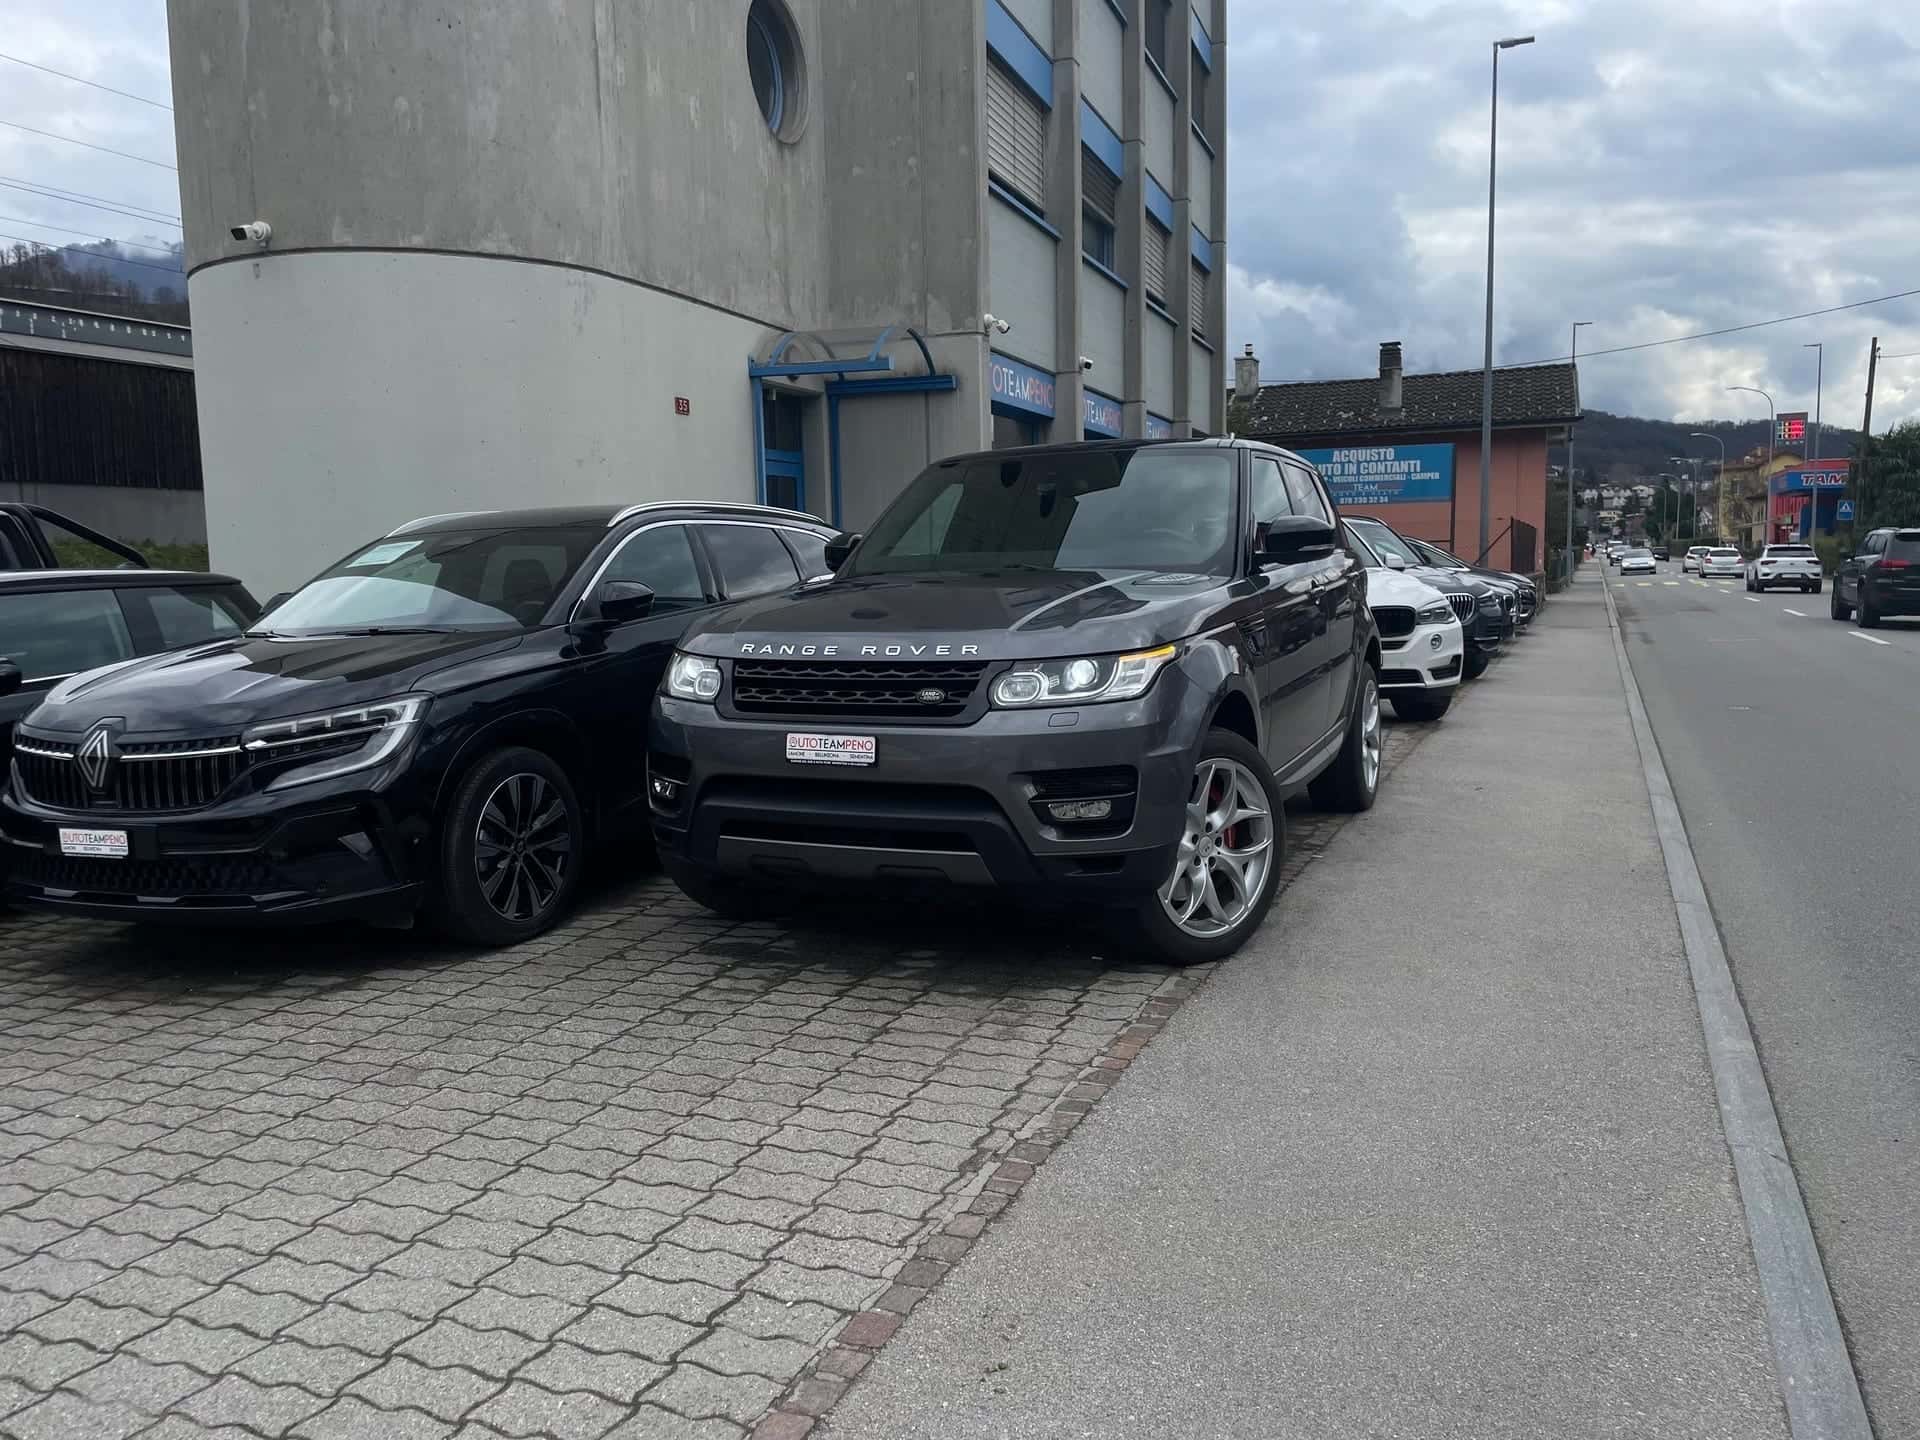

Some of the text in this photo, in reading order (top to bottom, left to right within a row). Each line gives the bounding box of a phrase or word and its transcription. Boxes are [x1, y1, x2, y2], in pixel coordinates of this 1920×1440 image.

[990, 362, 1055, 409] OTEAMPENO
[1333, 448, 1395, 463] ACQUISTO
[1344, 463, 1357, 475] IN
[1360, 460, 1421, 474] CONTANTI
[1411, 472, 1440, 480] CAMPER
[741, 644, 979, 656] RANGE ROVER
